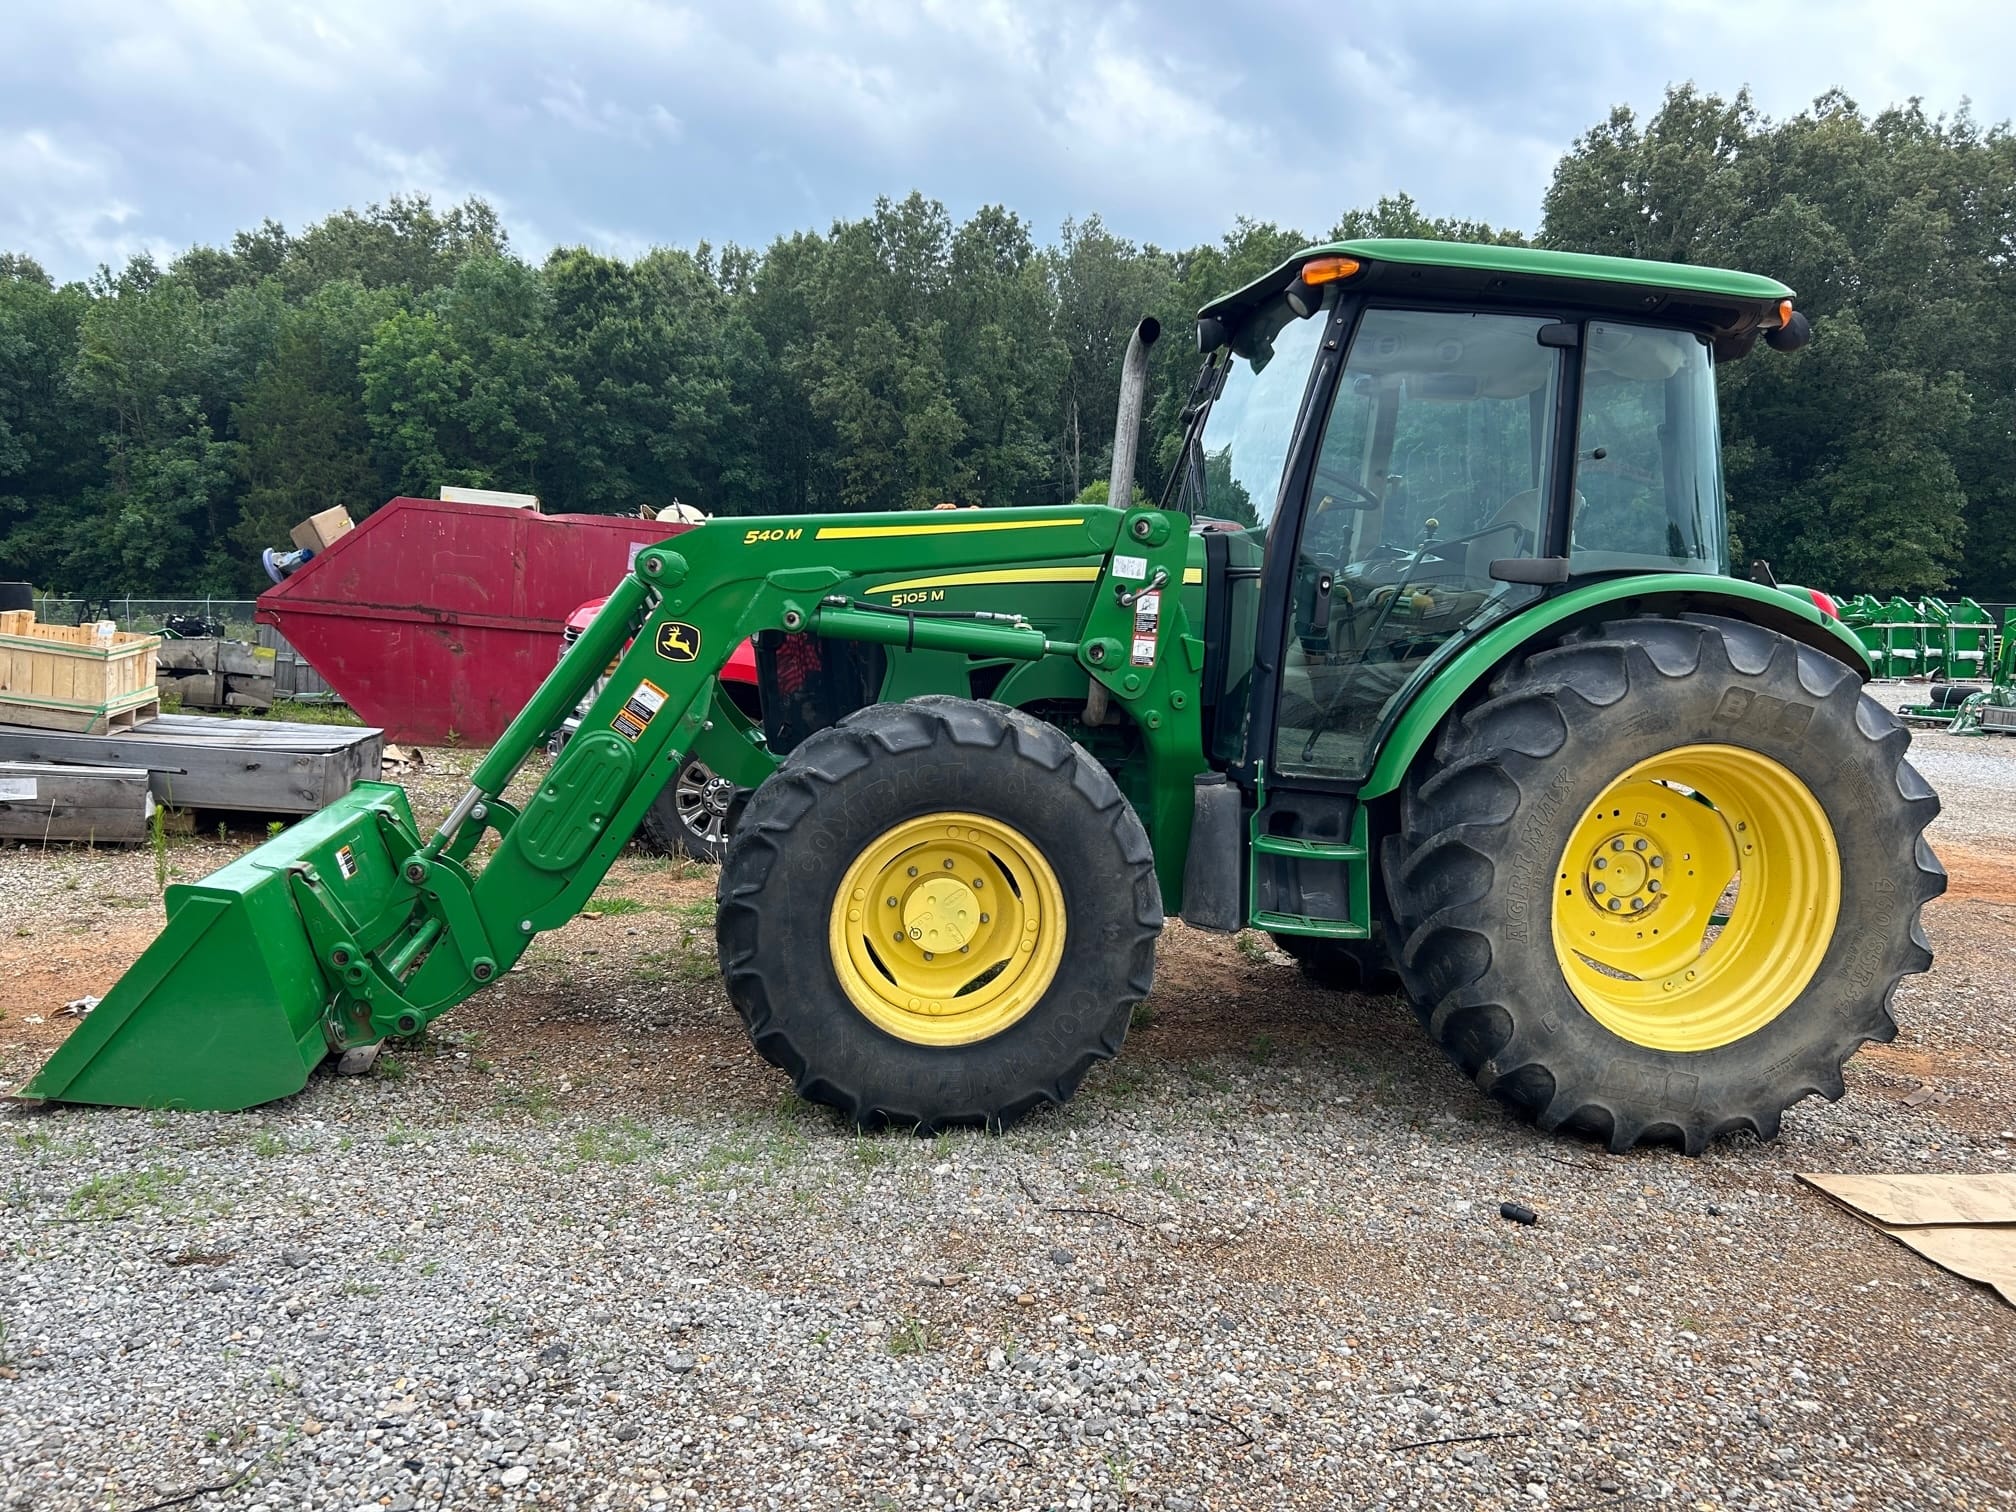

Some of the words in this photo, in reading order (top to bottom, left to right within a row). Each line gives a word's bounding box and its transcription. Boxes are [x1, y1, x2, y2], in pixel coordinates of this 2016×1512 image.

[743, 529, 785, 545] 540
[785, 528, 803, 540] M
[891, 591, 928, 607] 5105
[930, 589, 945, 601] M
[1505, 853, 1535, 944] AGRI
[1521, 766, 1576, 852] MAX
[1840, 878, 1896, 1019] 460/85R34
